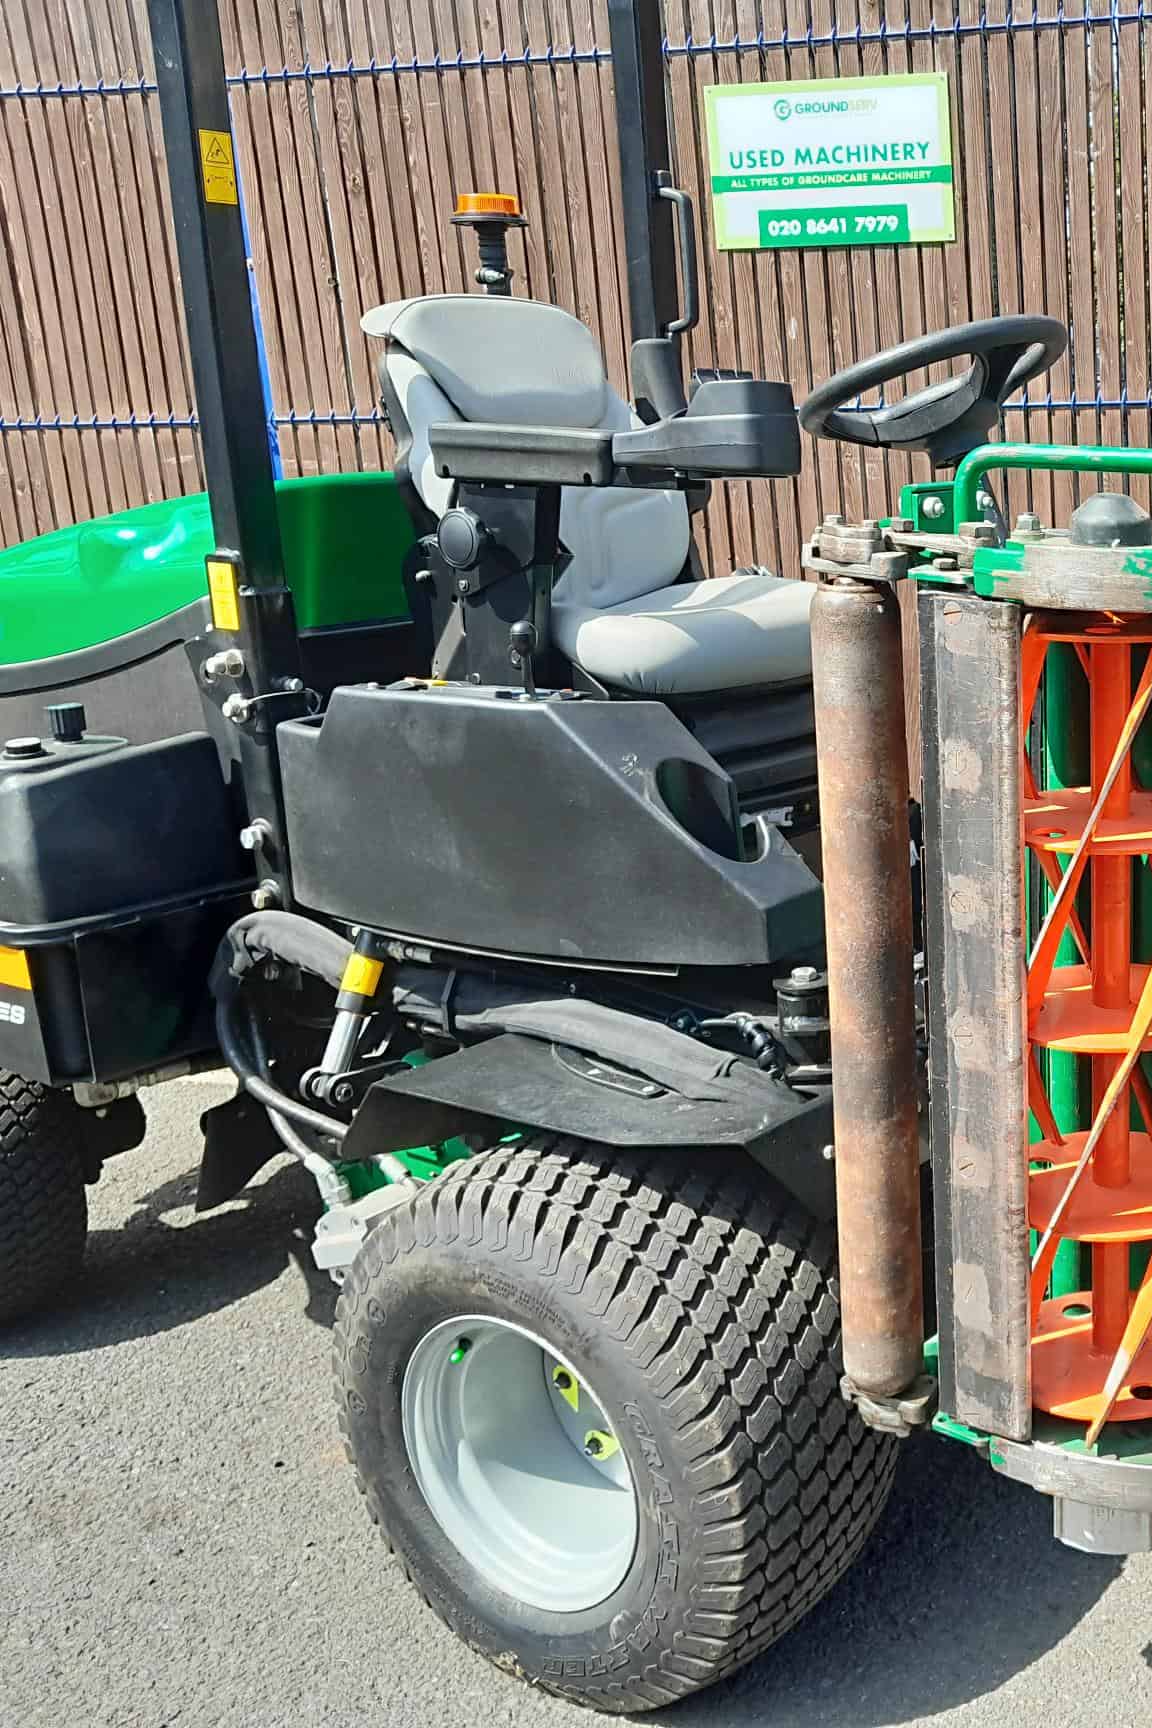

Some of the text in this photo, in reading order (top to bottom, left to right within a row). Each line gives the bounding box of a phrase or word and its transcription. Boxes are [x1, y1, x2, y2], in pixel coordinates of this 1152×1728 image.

[729, 141, 931, 169] USED MACHINERY
[731, 170, 932, 188] ALL TYPES OF GROUNDCARE MACHINERY
[768, 215, 898, 236] 020 8641 7979
